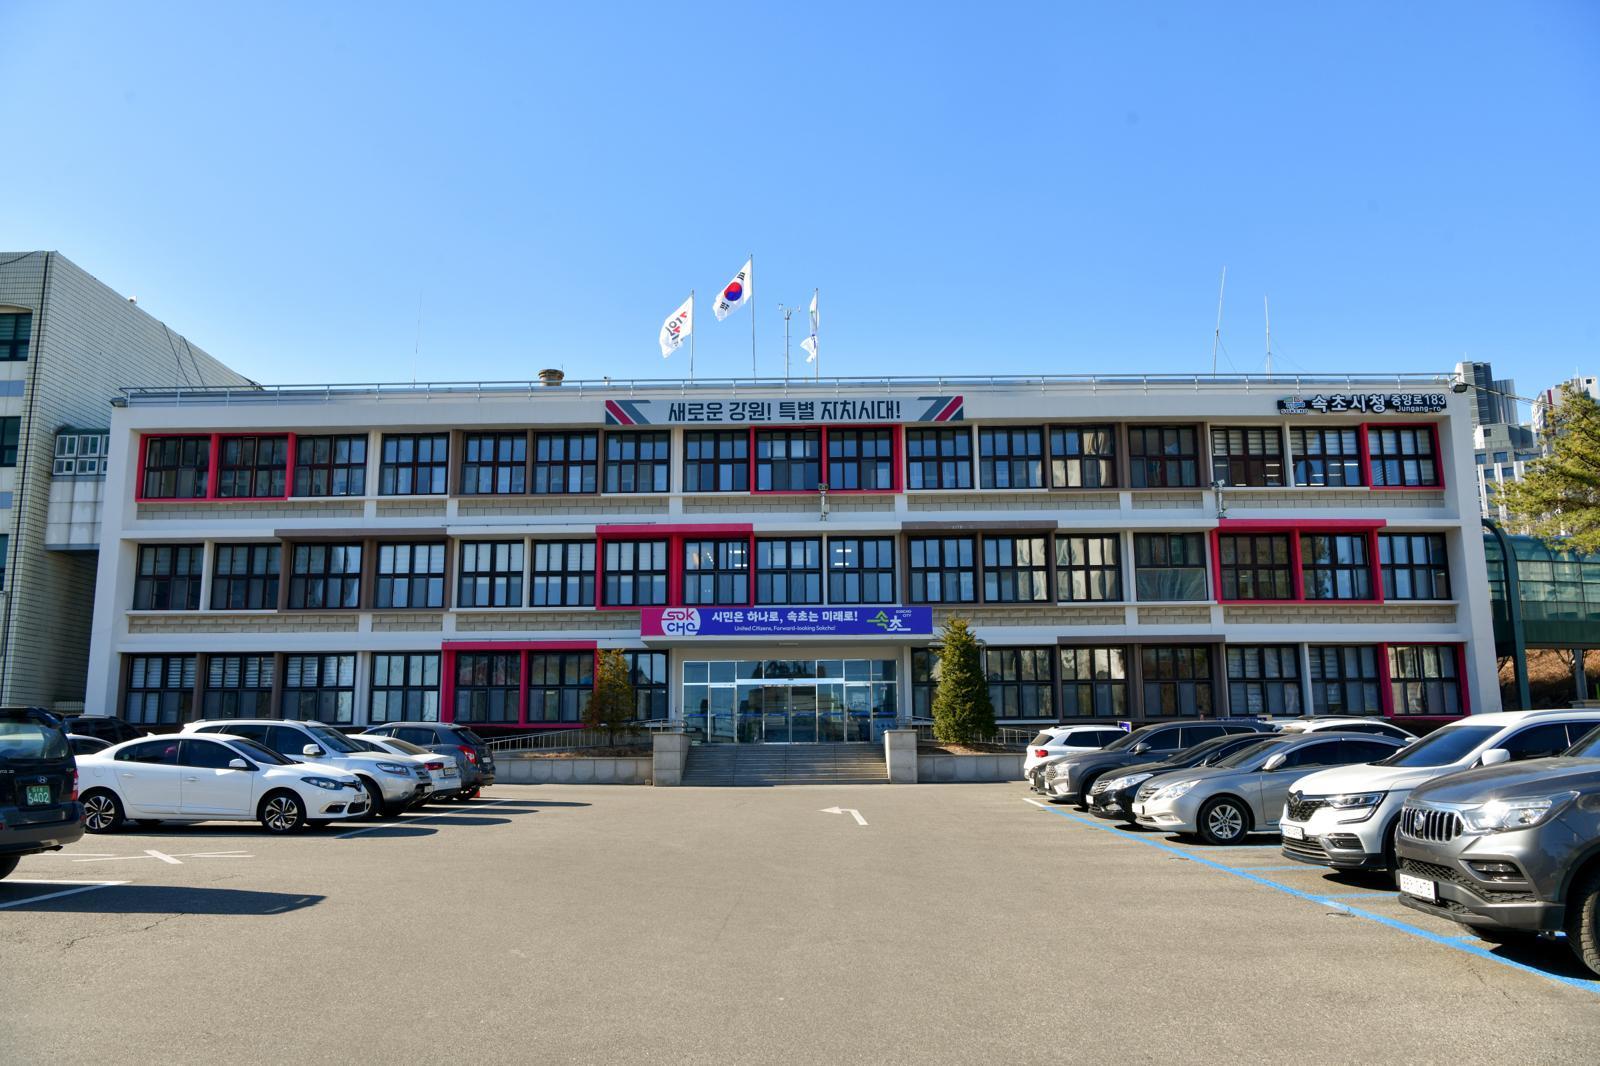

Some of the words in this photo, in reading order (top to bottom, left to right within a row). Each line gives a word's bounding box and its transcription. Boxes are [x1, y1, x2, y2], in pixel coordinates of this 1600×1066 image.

[1311, 395, 1386, 413] 속초시청
[1391, 394, 1446, 406] 중앙로183
[1396, 405, 1442, 413] Jungang-ro
[668, 402, 724, 422] 새로운
[728, 401, 772, 421] 강원!
[778, 401, 815, 421] 특별
[821, 400, 901, 421] 자치시대!
[712, 611, 743, 622] 시민은
[747, 611, 783, 624] 하나로,
[787, 611, 818, 622] 속초는
[822, 611, 858, 621] 미래로!
[667, 622, 699, 635] CHO
[28, 792, 49, 803] 5402
